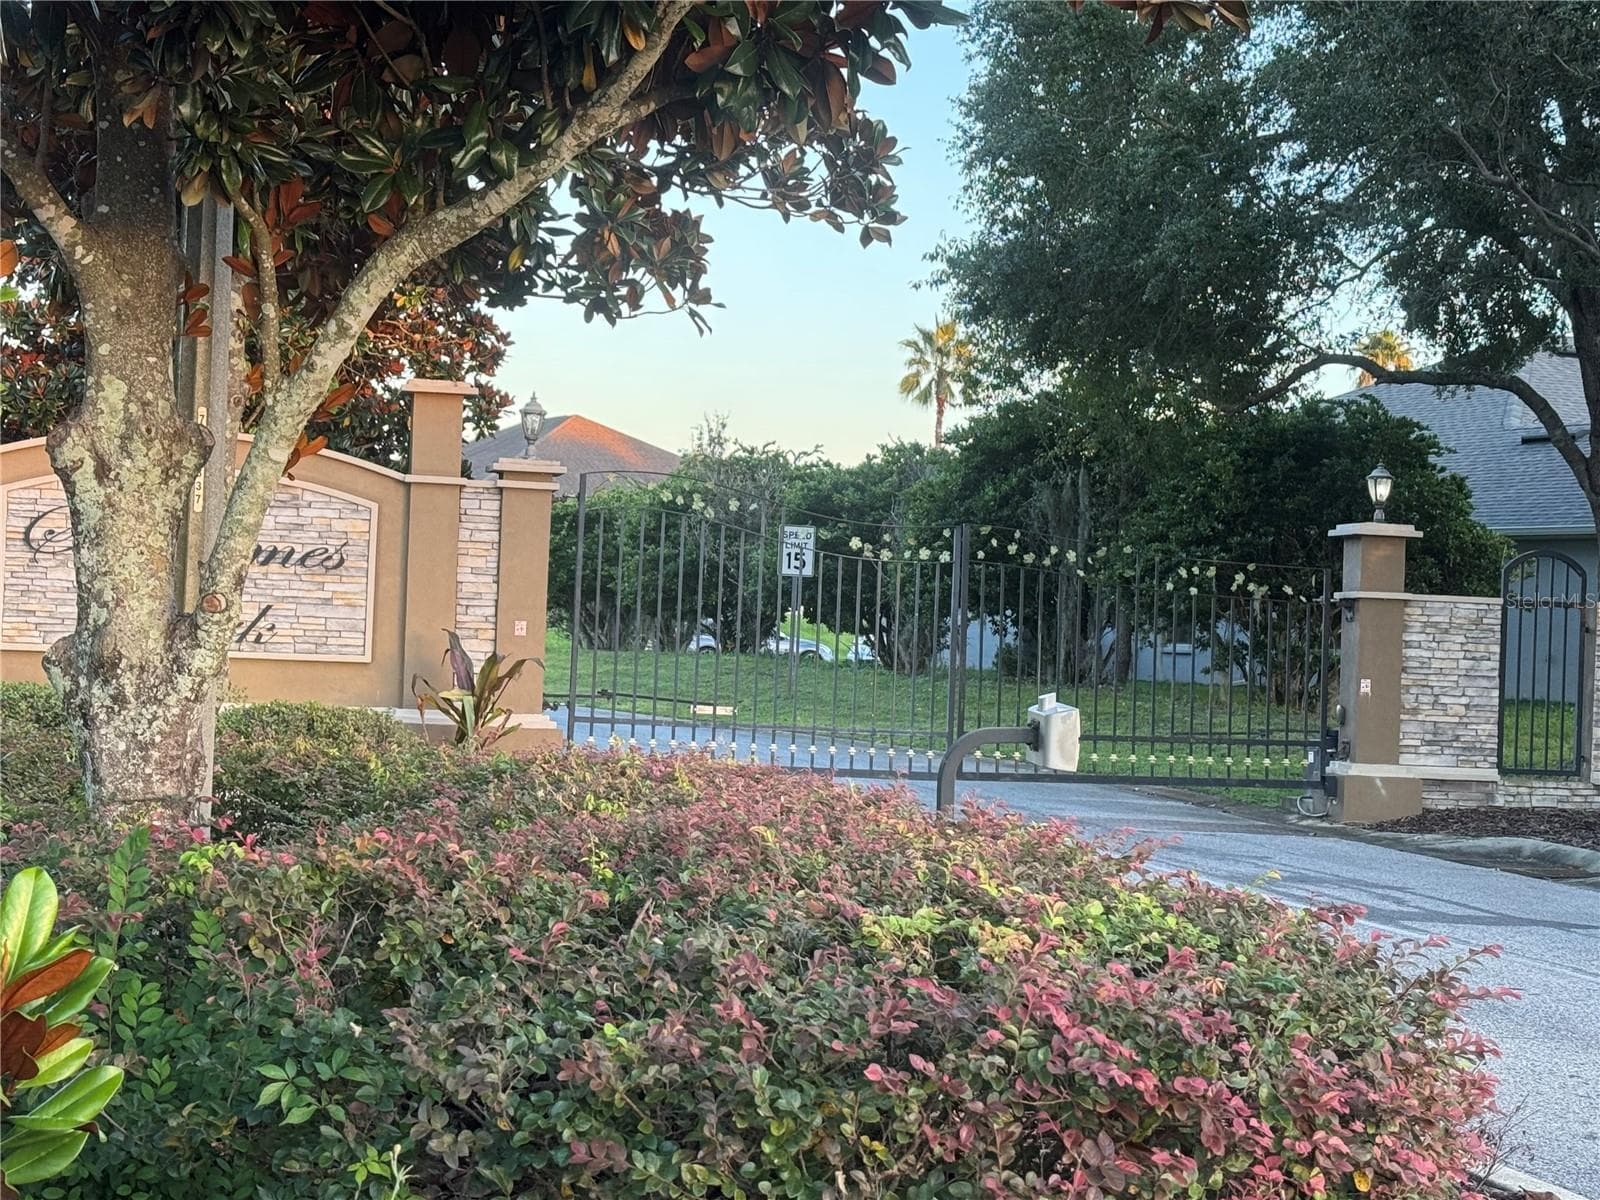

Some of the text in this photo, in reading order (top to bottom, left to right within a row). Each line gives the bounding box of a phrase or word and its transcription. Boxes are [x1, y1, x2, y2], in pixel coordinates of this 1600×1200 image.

[783, 531, 812, 540] SPED
[251, 539, 349, 570] mes
[786, 552, 806, 570] 15
